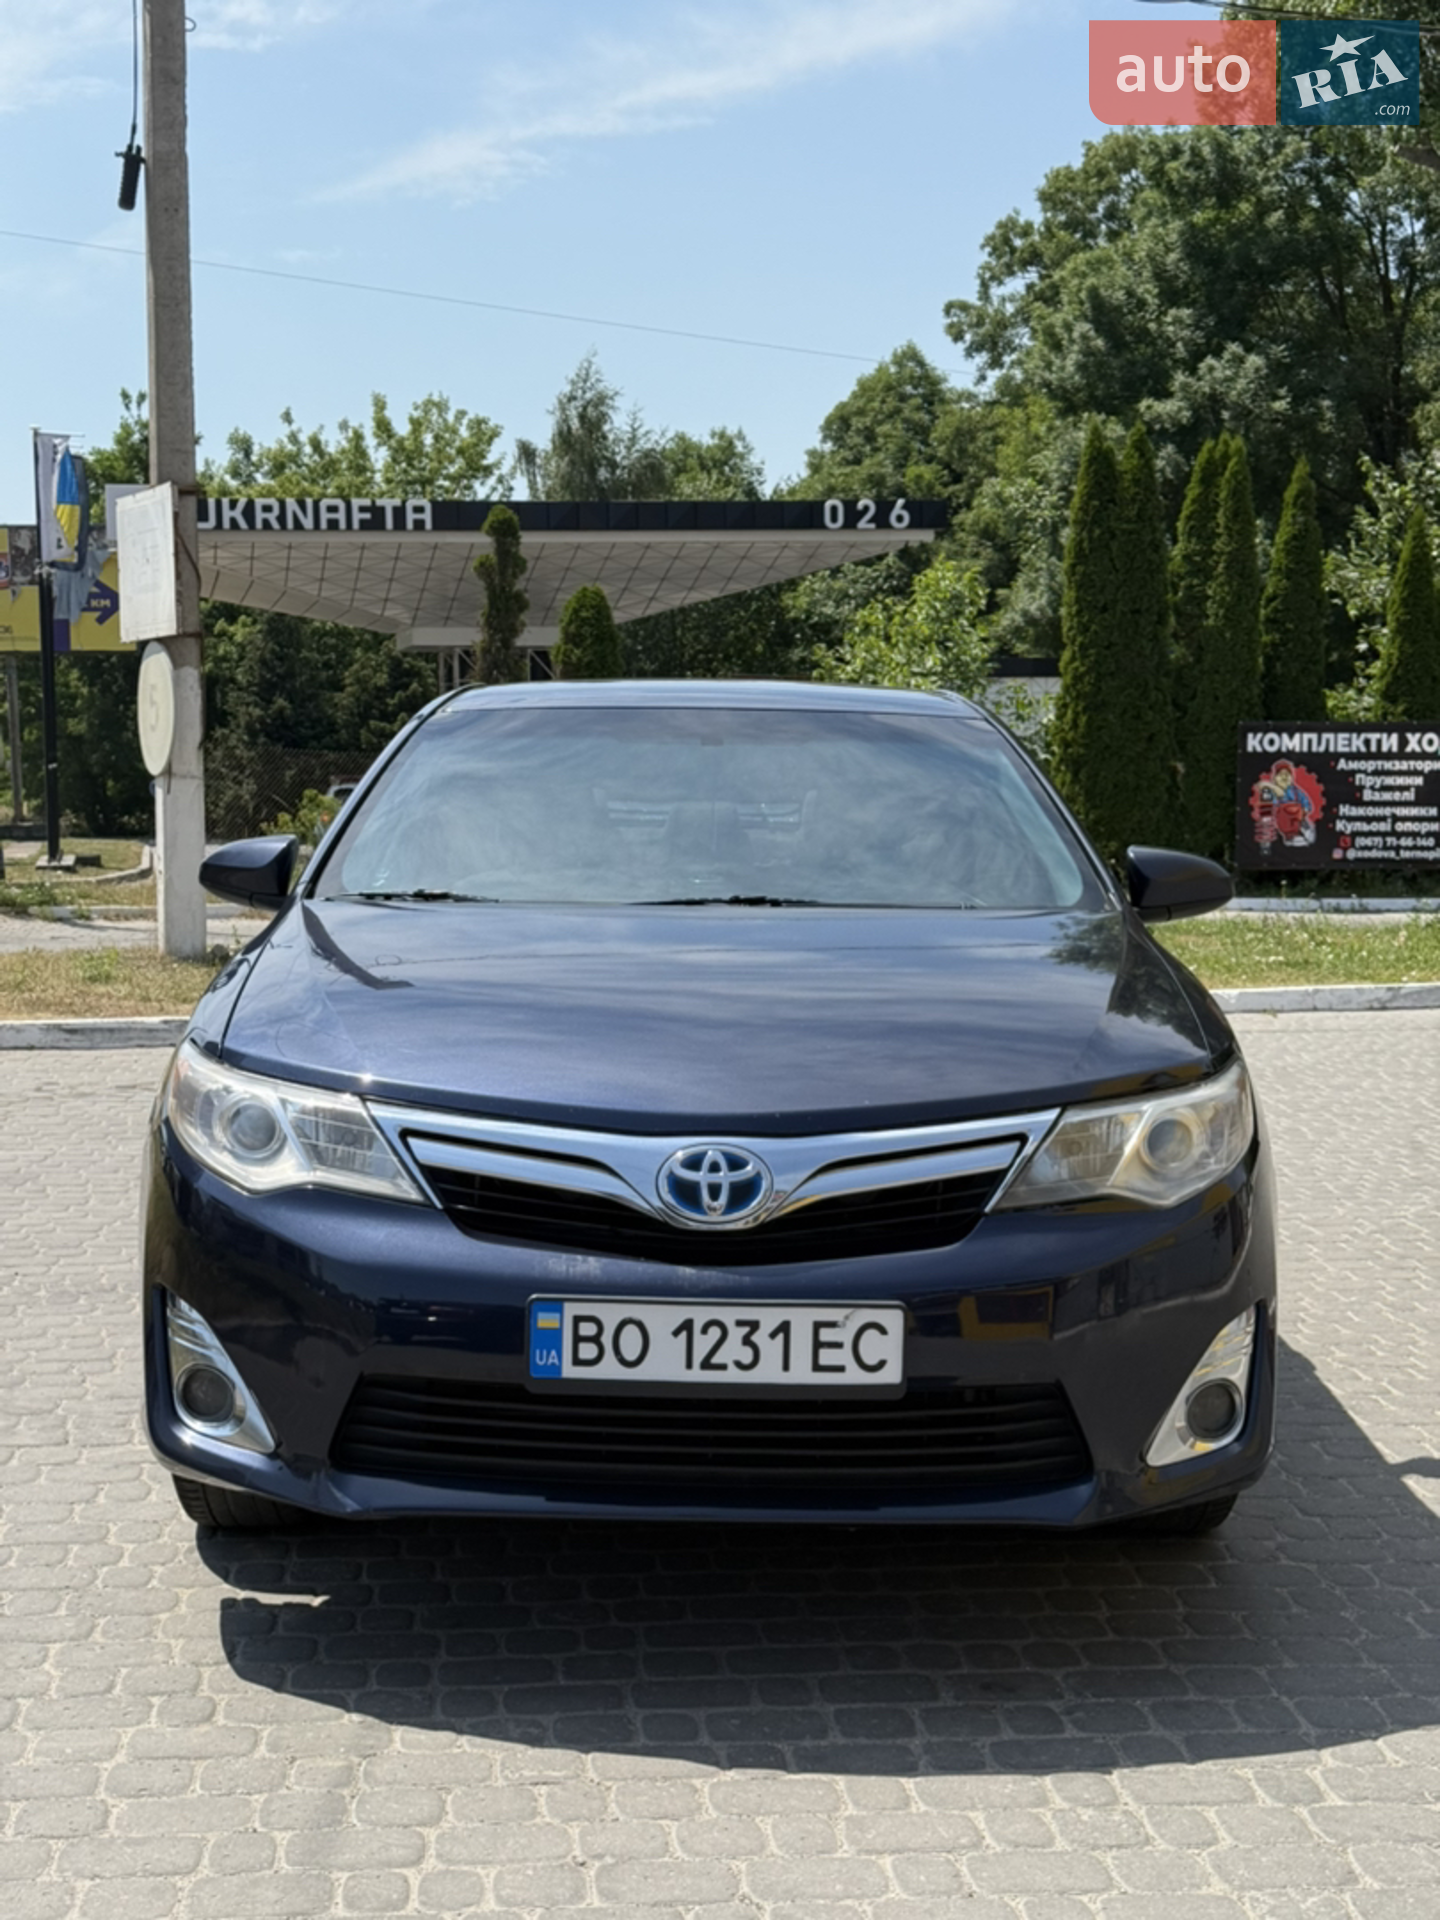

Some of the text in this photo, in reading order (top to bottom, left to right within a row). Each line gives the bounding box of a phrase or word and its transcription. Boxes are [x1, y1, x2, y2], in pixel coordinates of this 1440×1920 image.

[1246, 732, 1440, 754] КОМПЛЕКТИ ХО
[1355, 774, 1424, 787] Пружини
[1362, 787, 1416, 801] Важелі
[1338, 804, 1438, 817] Наконечники
[1335, 818, 1439, 834] Кульові опори
[571, 1314, 889, 1374] BO 1231 EC
[535, 1349, 560, 1366] UA
